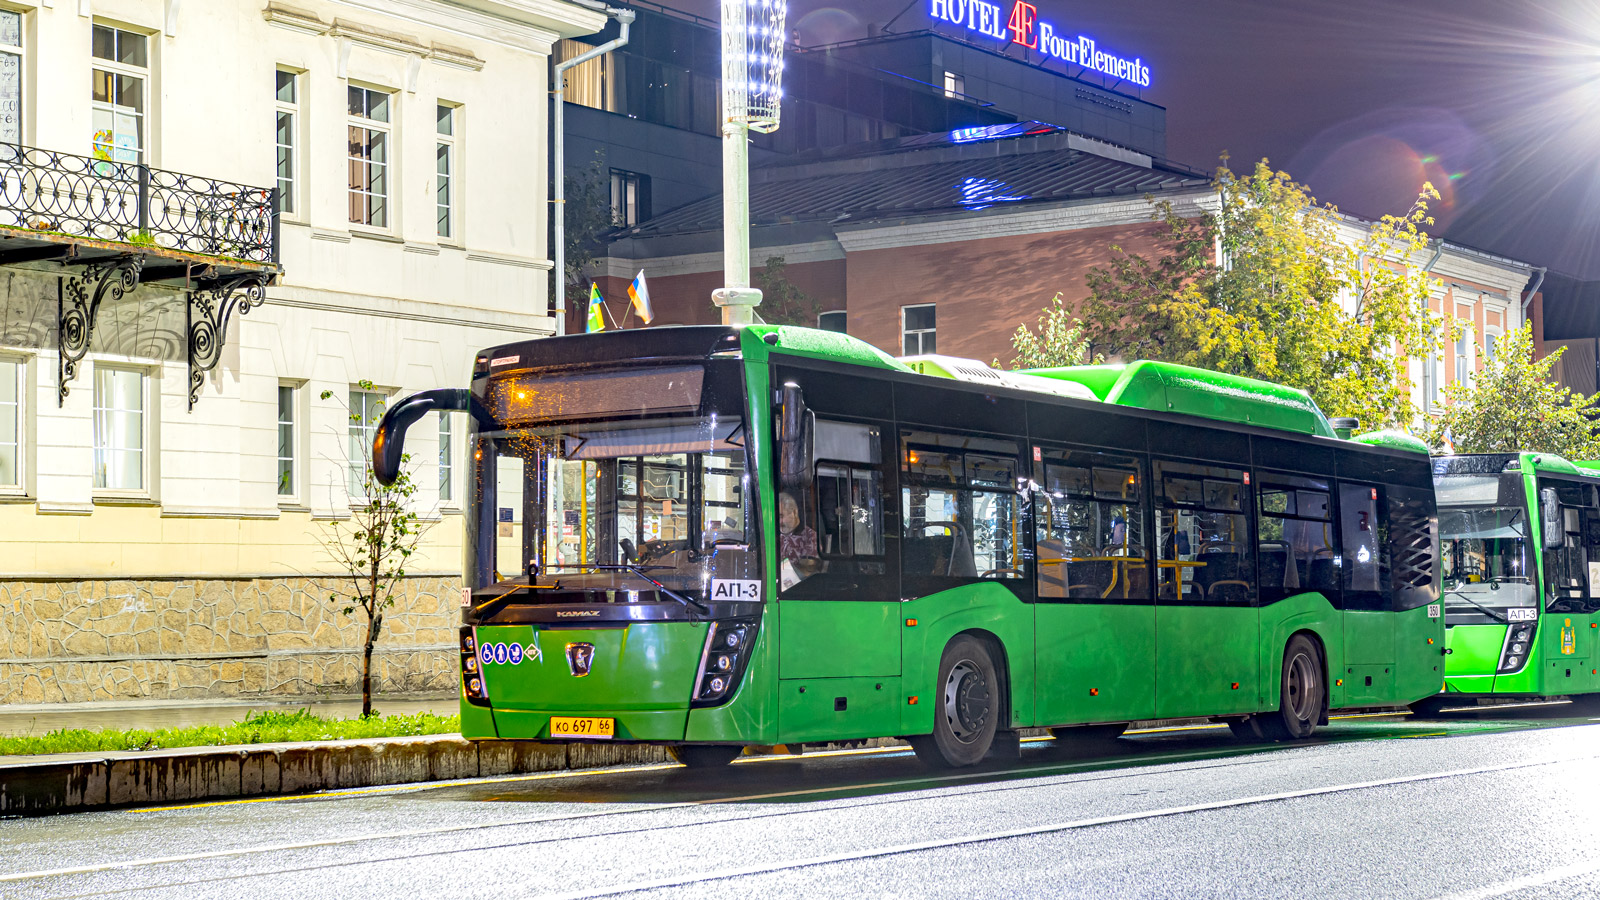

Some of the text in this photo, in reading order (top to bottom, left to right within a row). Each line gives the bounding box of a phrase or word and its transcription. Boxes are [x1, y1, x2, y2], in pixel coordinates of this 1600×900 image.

[931, 0, 1006, 40] HOTEL
[715, 583, 759, 599] АП-3
[556, 610, 601, 618] KAMAZ
[1429, 606, 1439, 617] 350
[1509, 609, 1536, 620] АП-3
[573, 719, 593, 733] 697
[599, 719, 610, 730] 66
